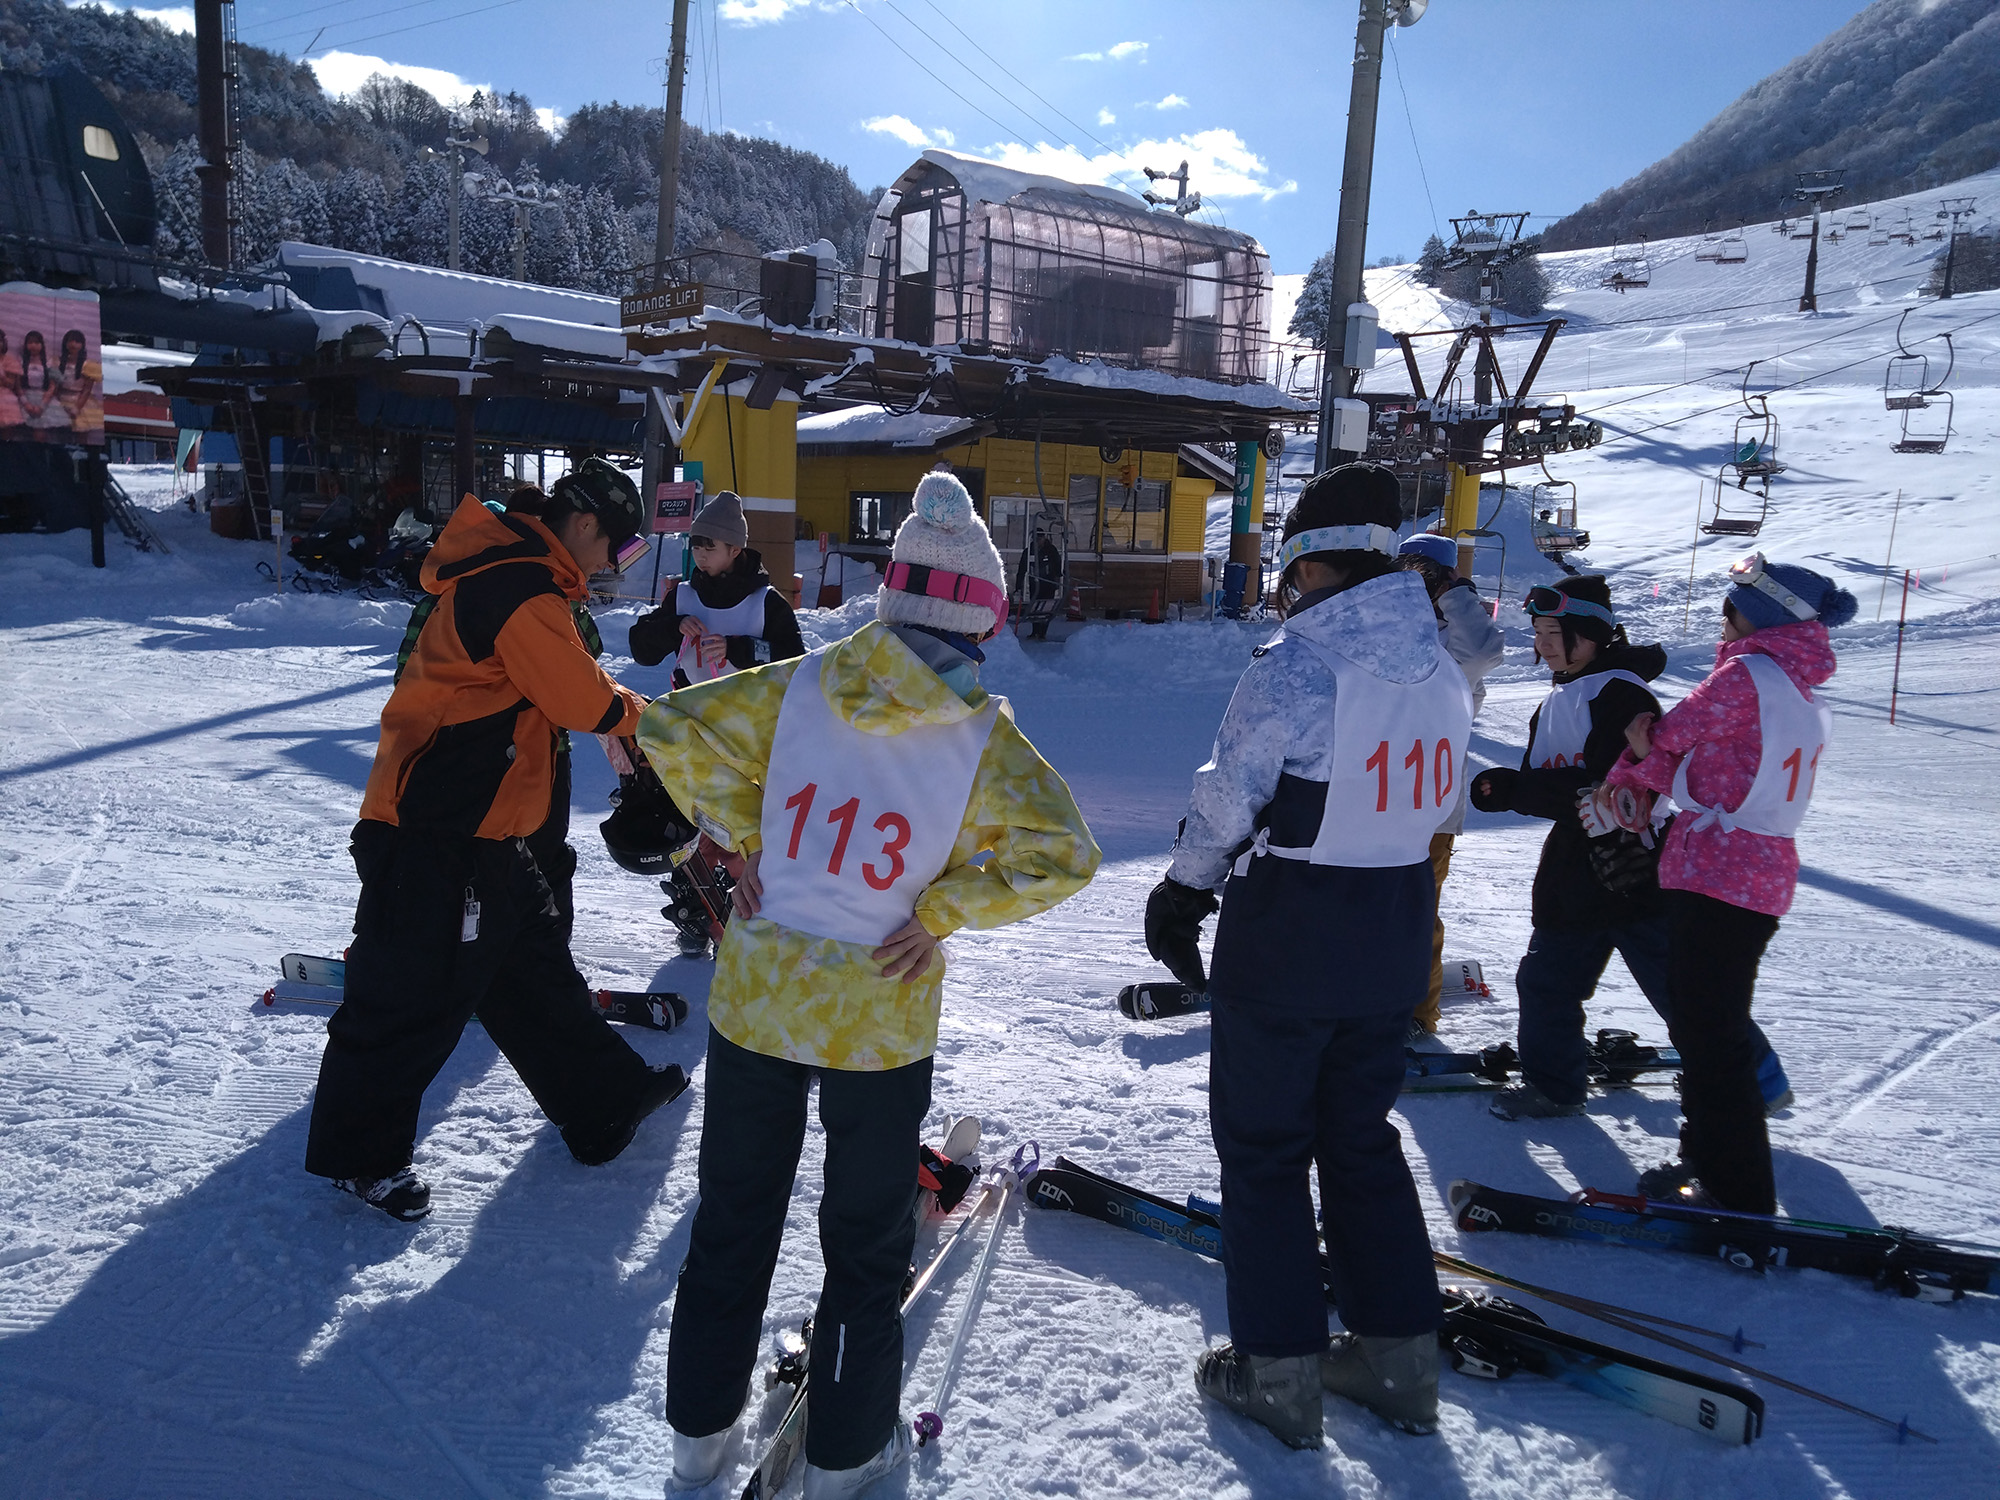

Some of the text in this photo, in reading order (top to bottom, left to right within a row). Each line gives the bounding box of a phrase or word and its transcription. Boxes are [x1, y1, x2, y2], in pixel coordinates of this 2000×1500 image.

[623, 289, 698, 315] ROMANCE LIFT
[661, 500, 687, 508] ロマンスリフト
[1366, 737, 1453, 812] 110
[784, 782, 912, 891] 113
[1106, 1200, 1219, 1254] PARABOLIC
[1535, 1211, 1673, 1244] PARABOLIC
[1698, 1398, 1717, 1430] 60
